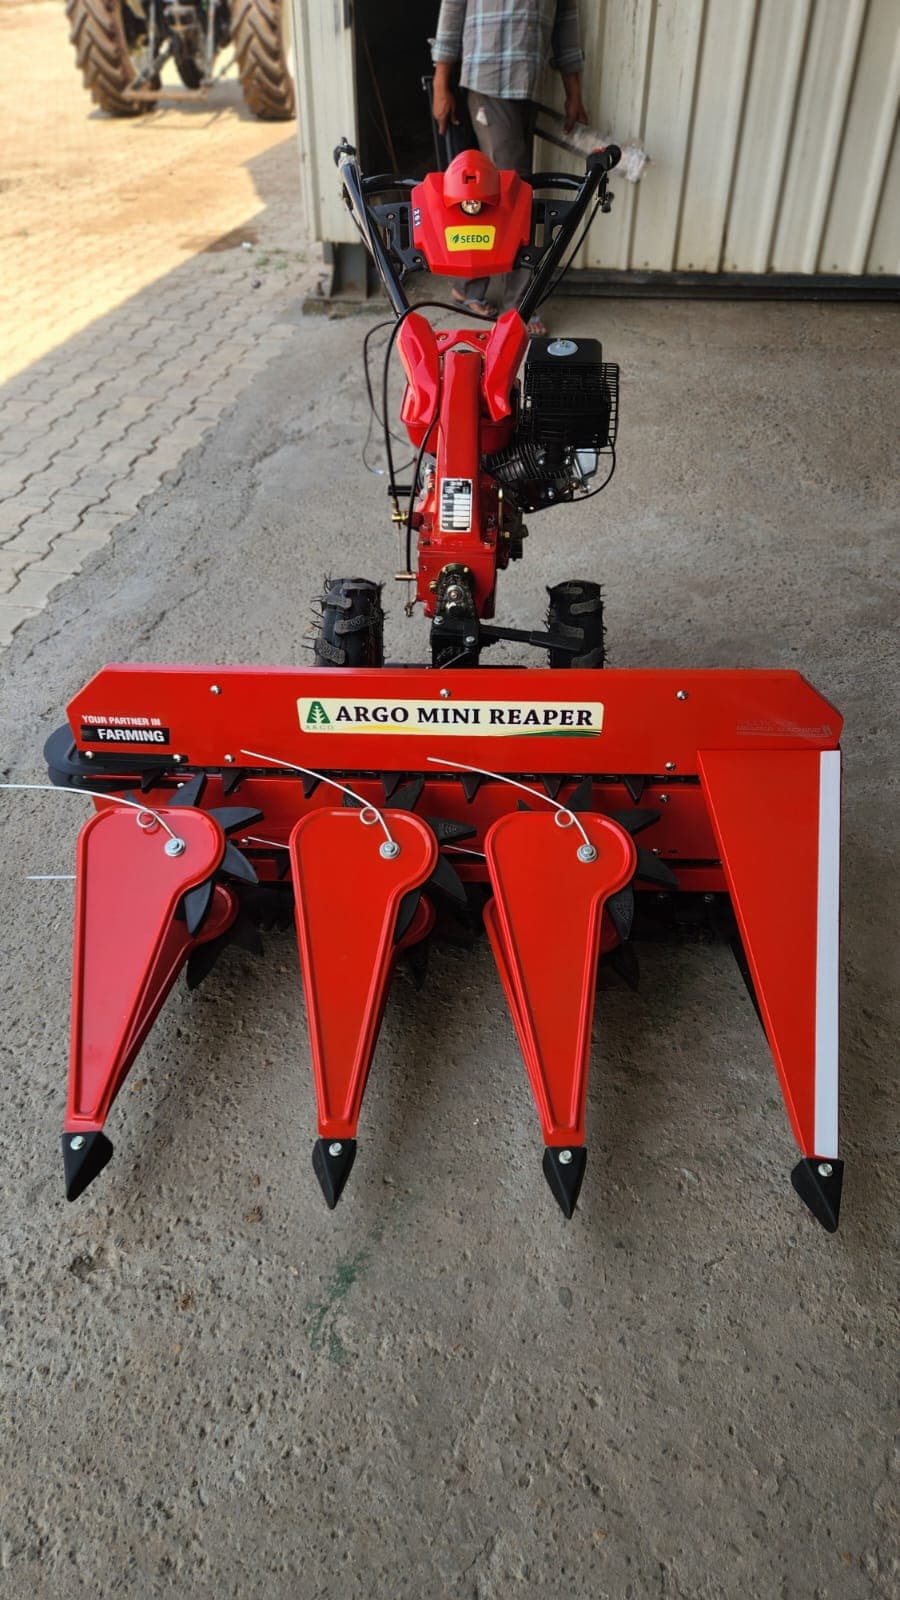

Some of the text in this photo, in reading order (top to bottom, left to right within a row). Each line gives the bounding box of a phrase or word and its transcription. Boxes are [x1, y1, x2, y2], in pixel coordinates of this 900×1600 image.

[460, 234, 490, 243] SEEDO
[81, 715, 161, 726] YOUR PARTNER IN
[336, 705, 593, 726] ARGO MINI REAPER
[97, 728, 166, 742] FARMING
